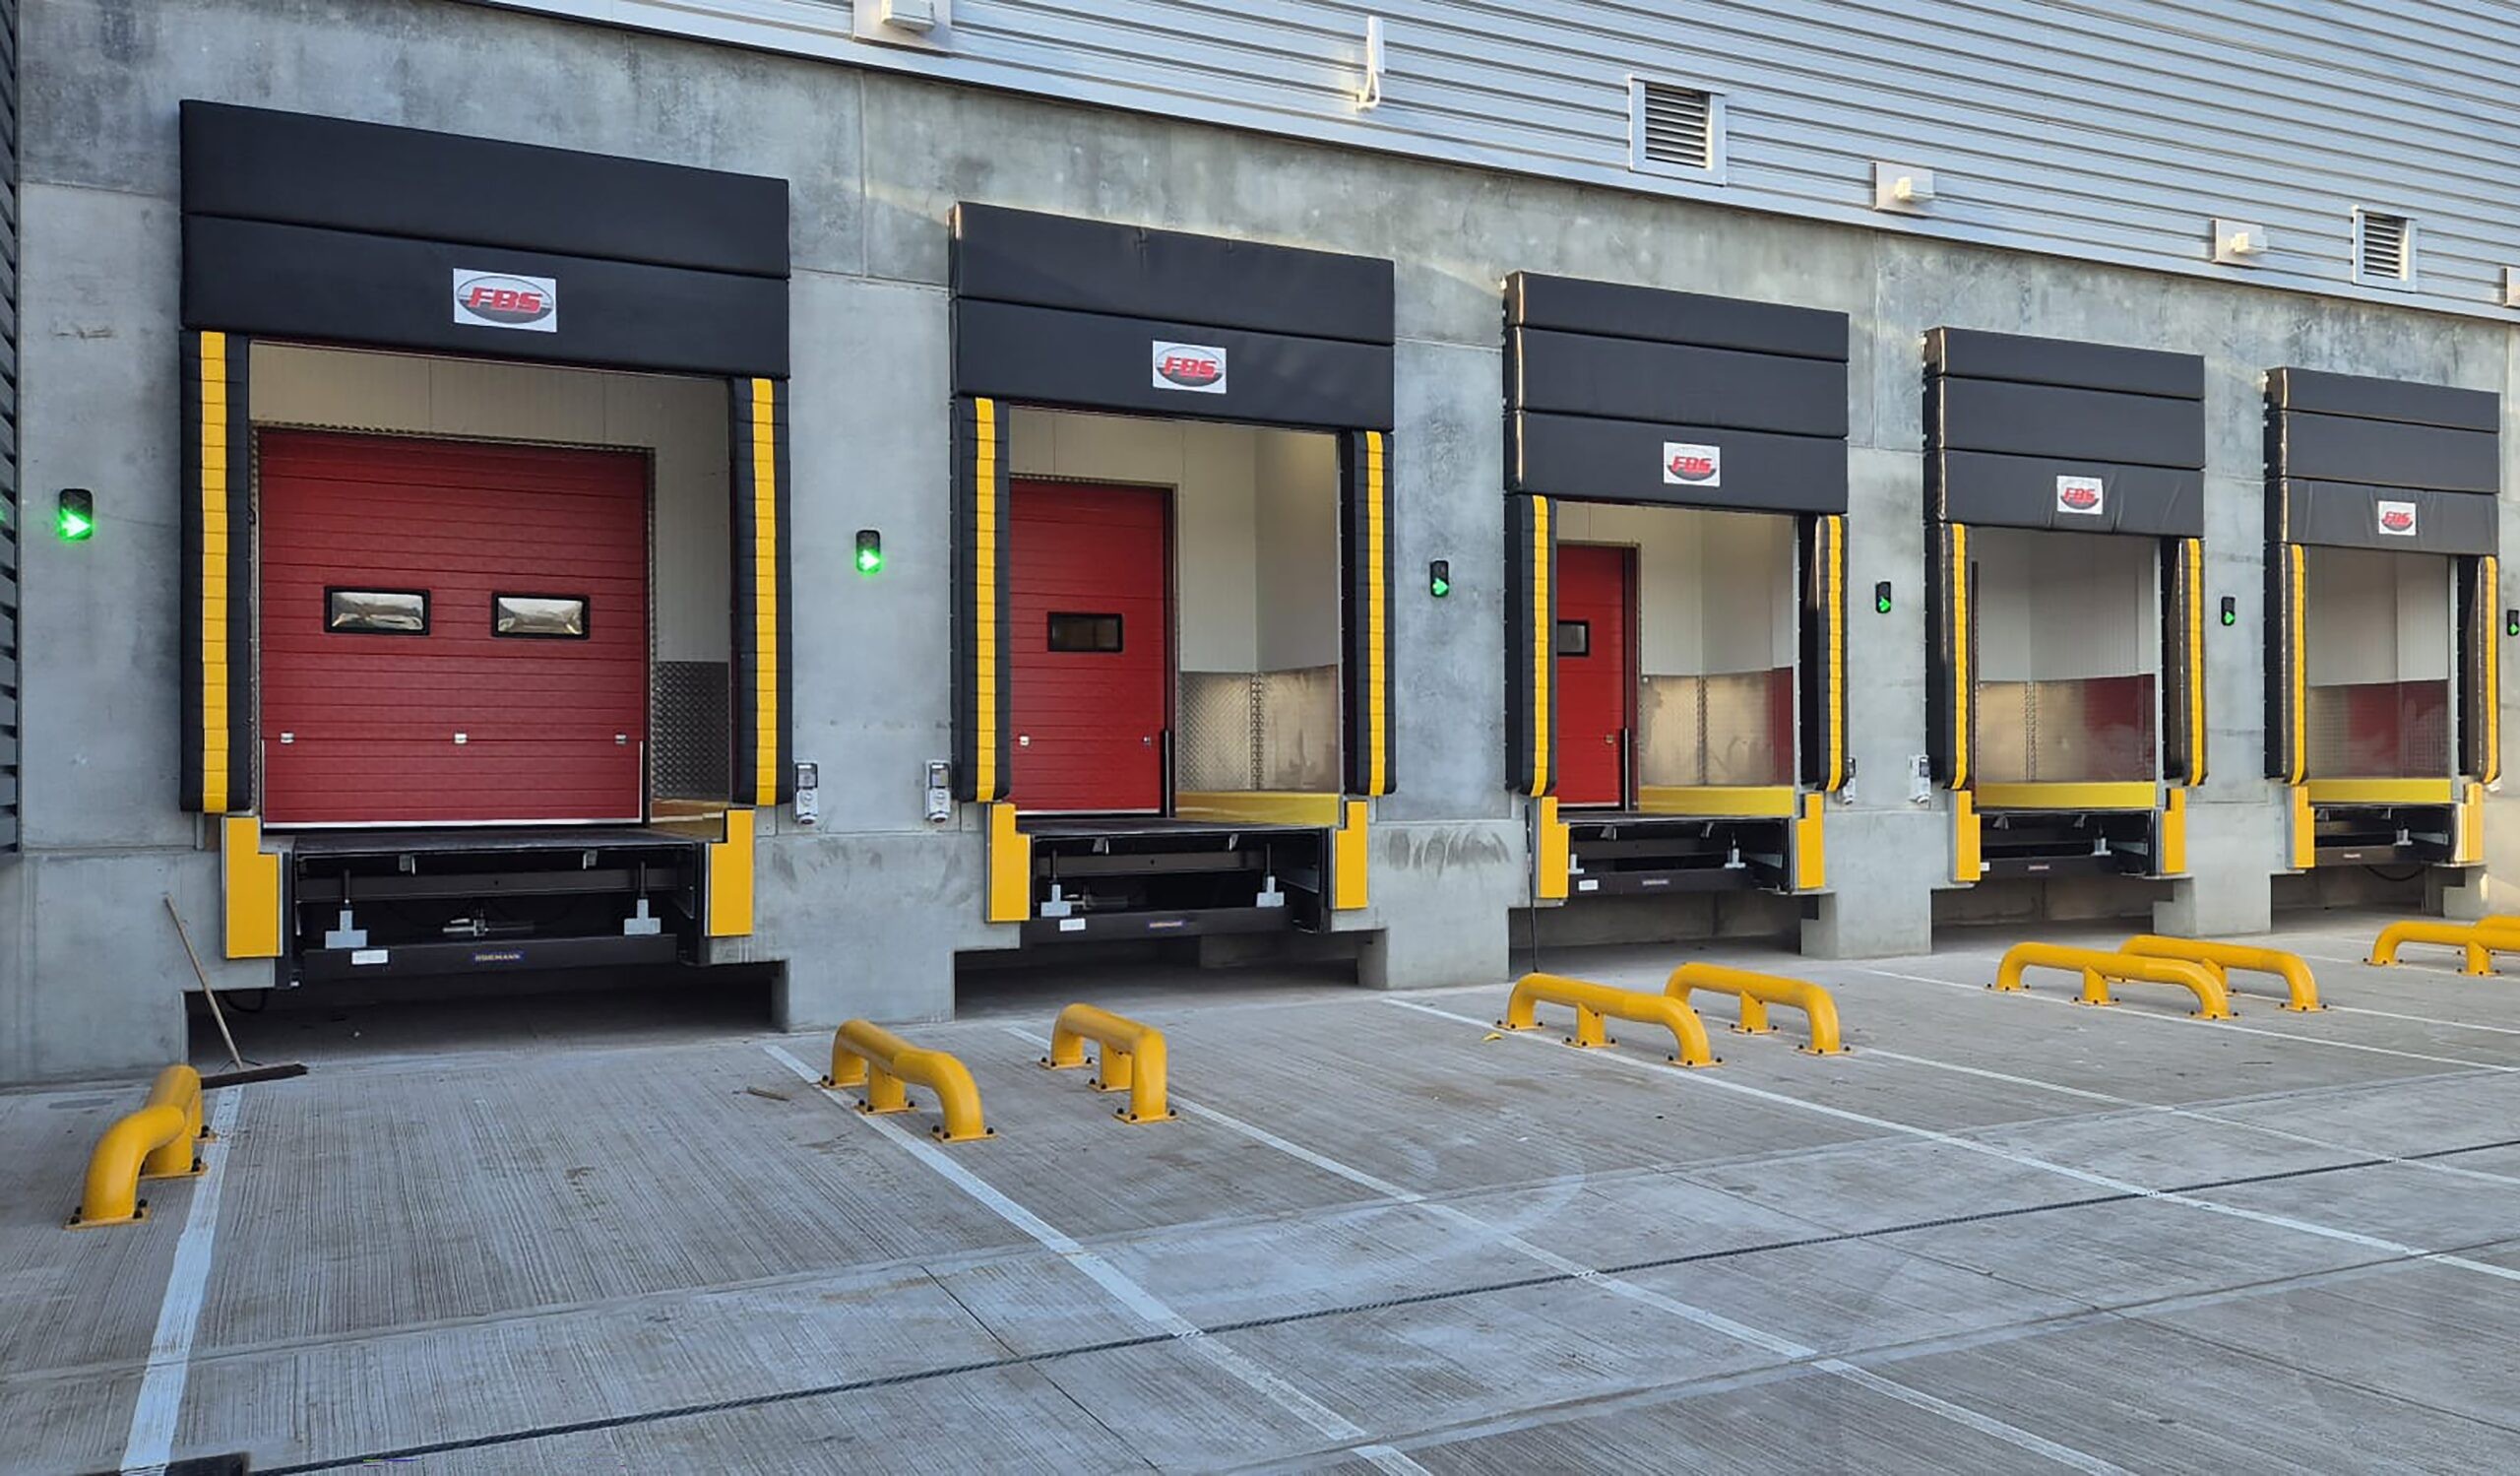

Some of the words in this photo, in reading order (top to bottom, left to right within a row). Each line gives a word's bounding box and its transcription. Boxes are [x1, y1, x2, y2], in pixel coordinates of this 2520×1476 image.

[470, 288, 539, 312] FBS
[1165, 356, 1216, 380] FBS
[1671, 456, 1712, 474] FBS
[2063, 487, 2095, 503] FBS
